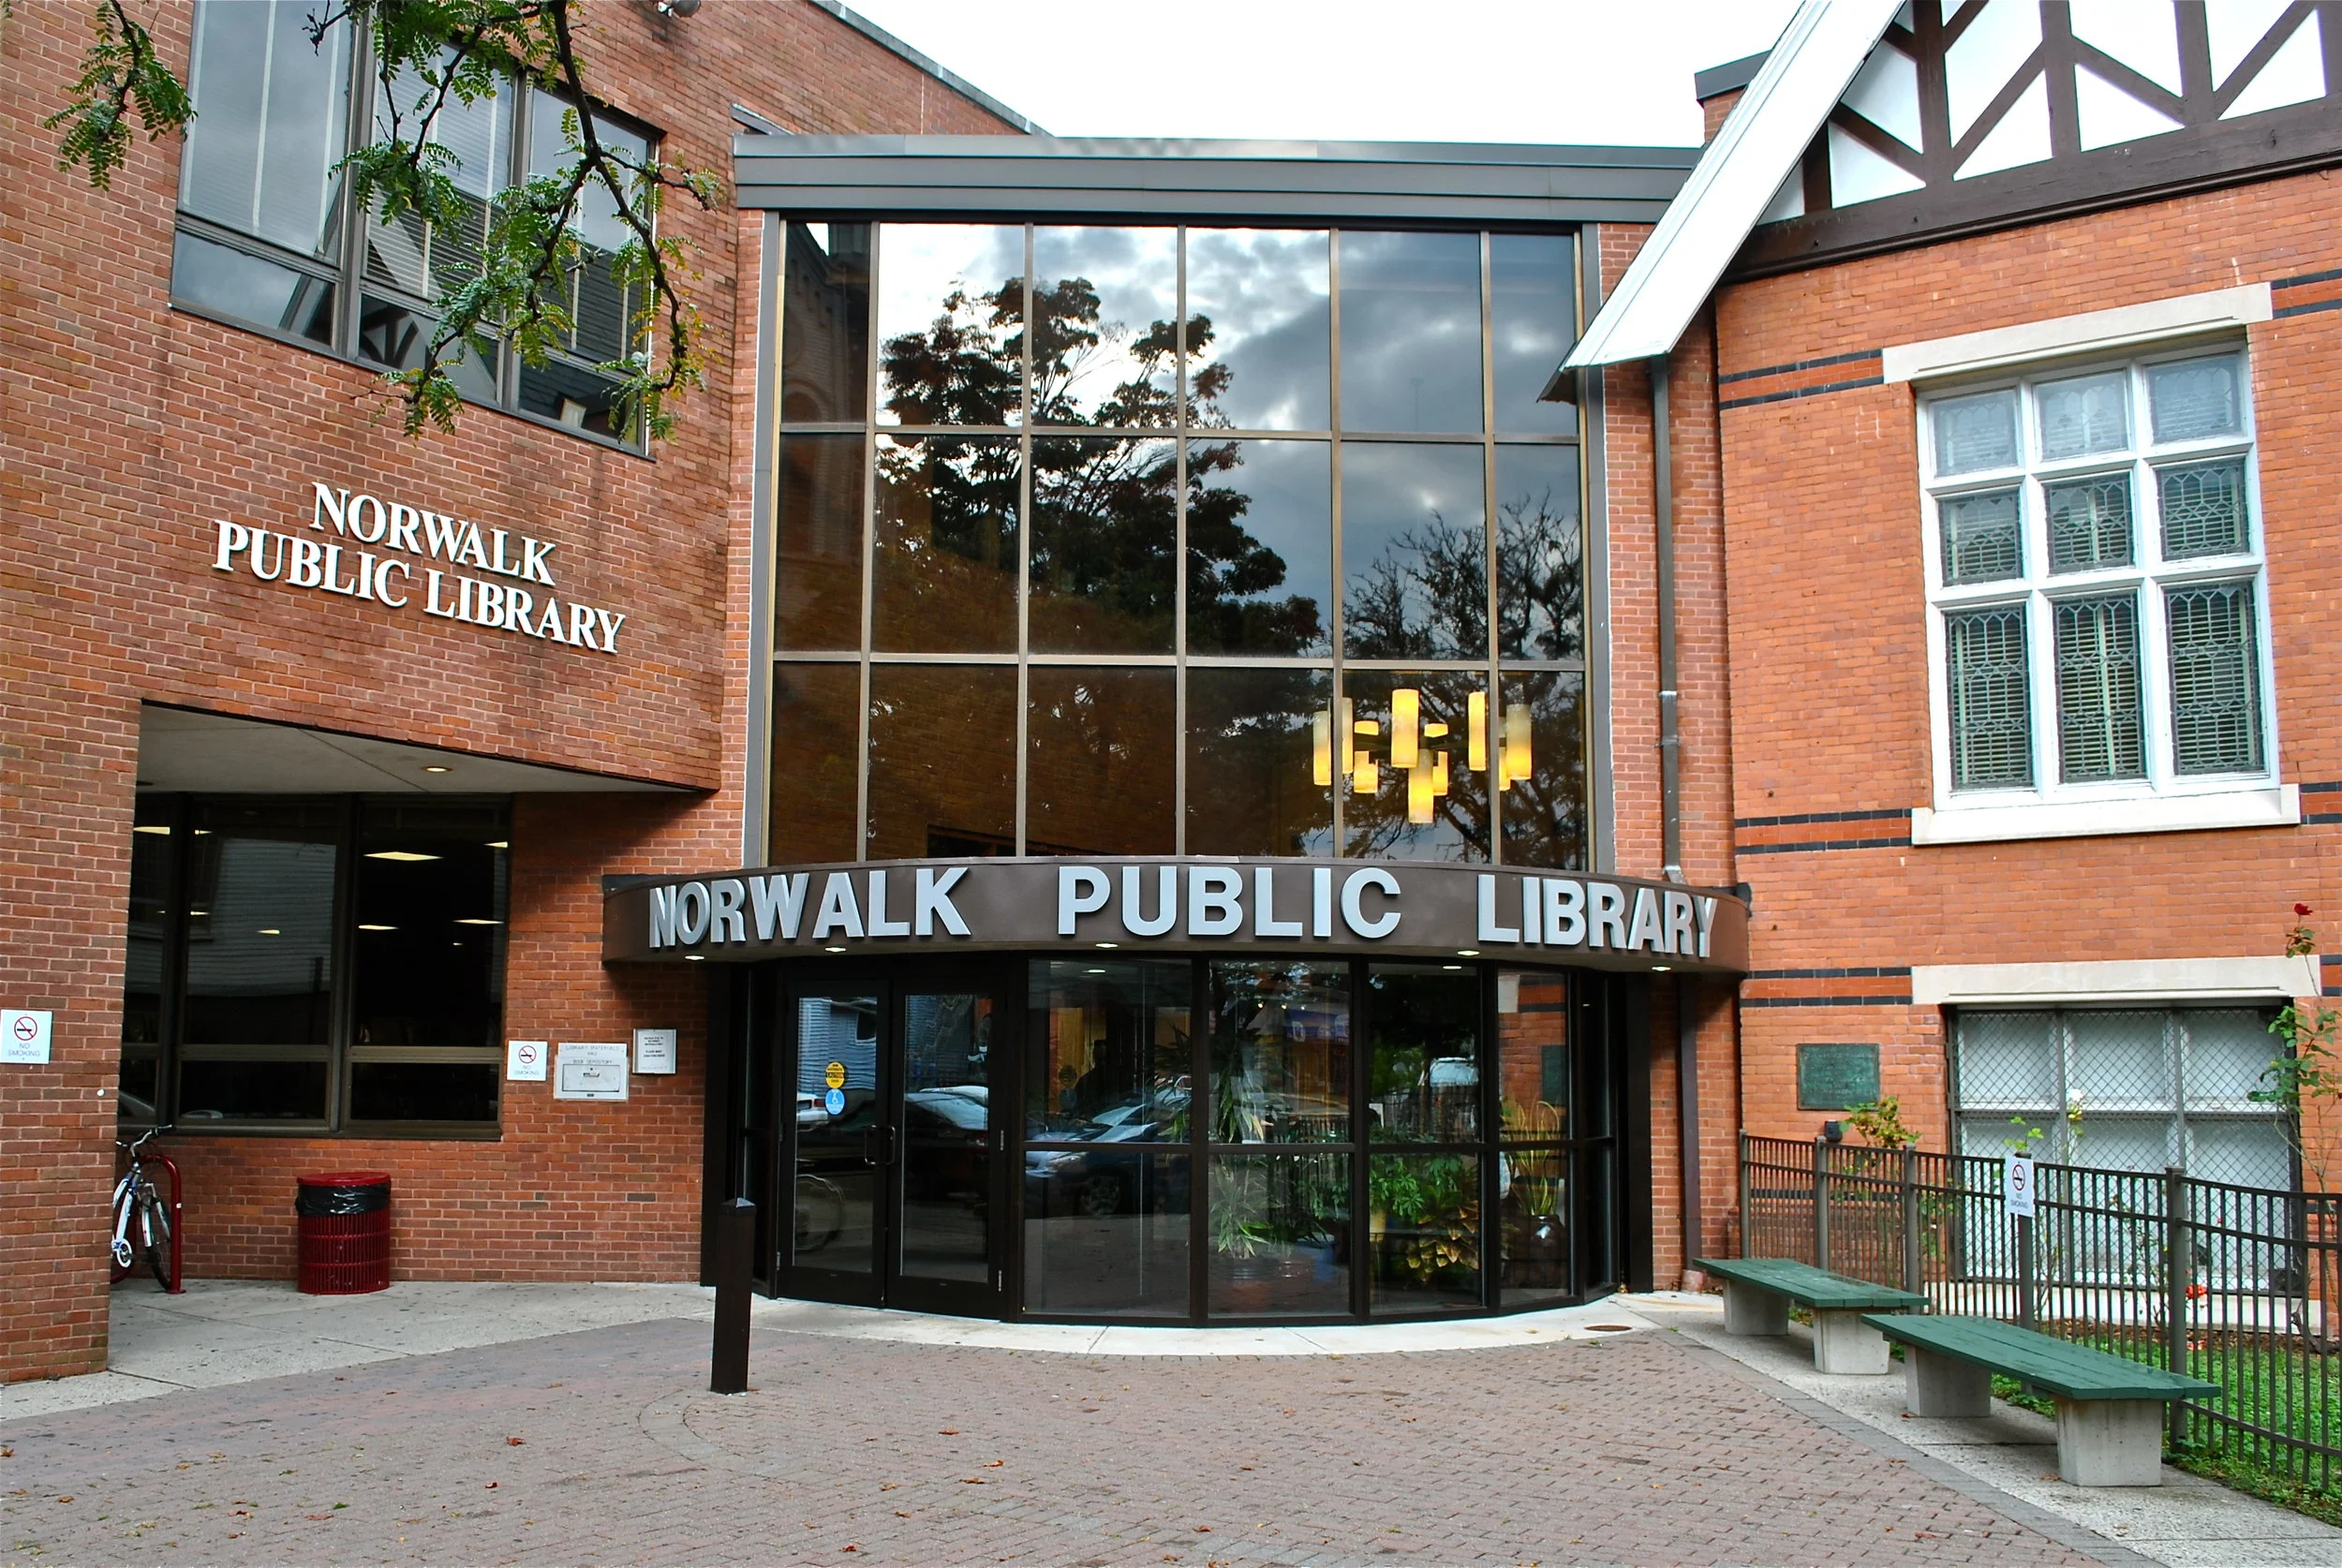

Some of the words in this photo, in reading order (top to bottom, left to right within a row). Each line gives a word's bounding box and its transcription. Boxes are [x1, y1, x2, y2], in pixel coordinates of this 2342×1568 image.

[212, 520, 410, 607] PUBLIC
[423, 568, 626, 653] LIBRARY
[309, 481, 556, 587] NORWALK
[649, 867, 971, 948] NORWALK
[1058, 865, 1401, 939] PUBLIC
[1477, 874, 1717, 958] LIBRARY
